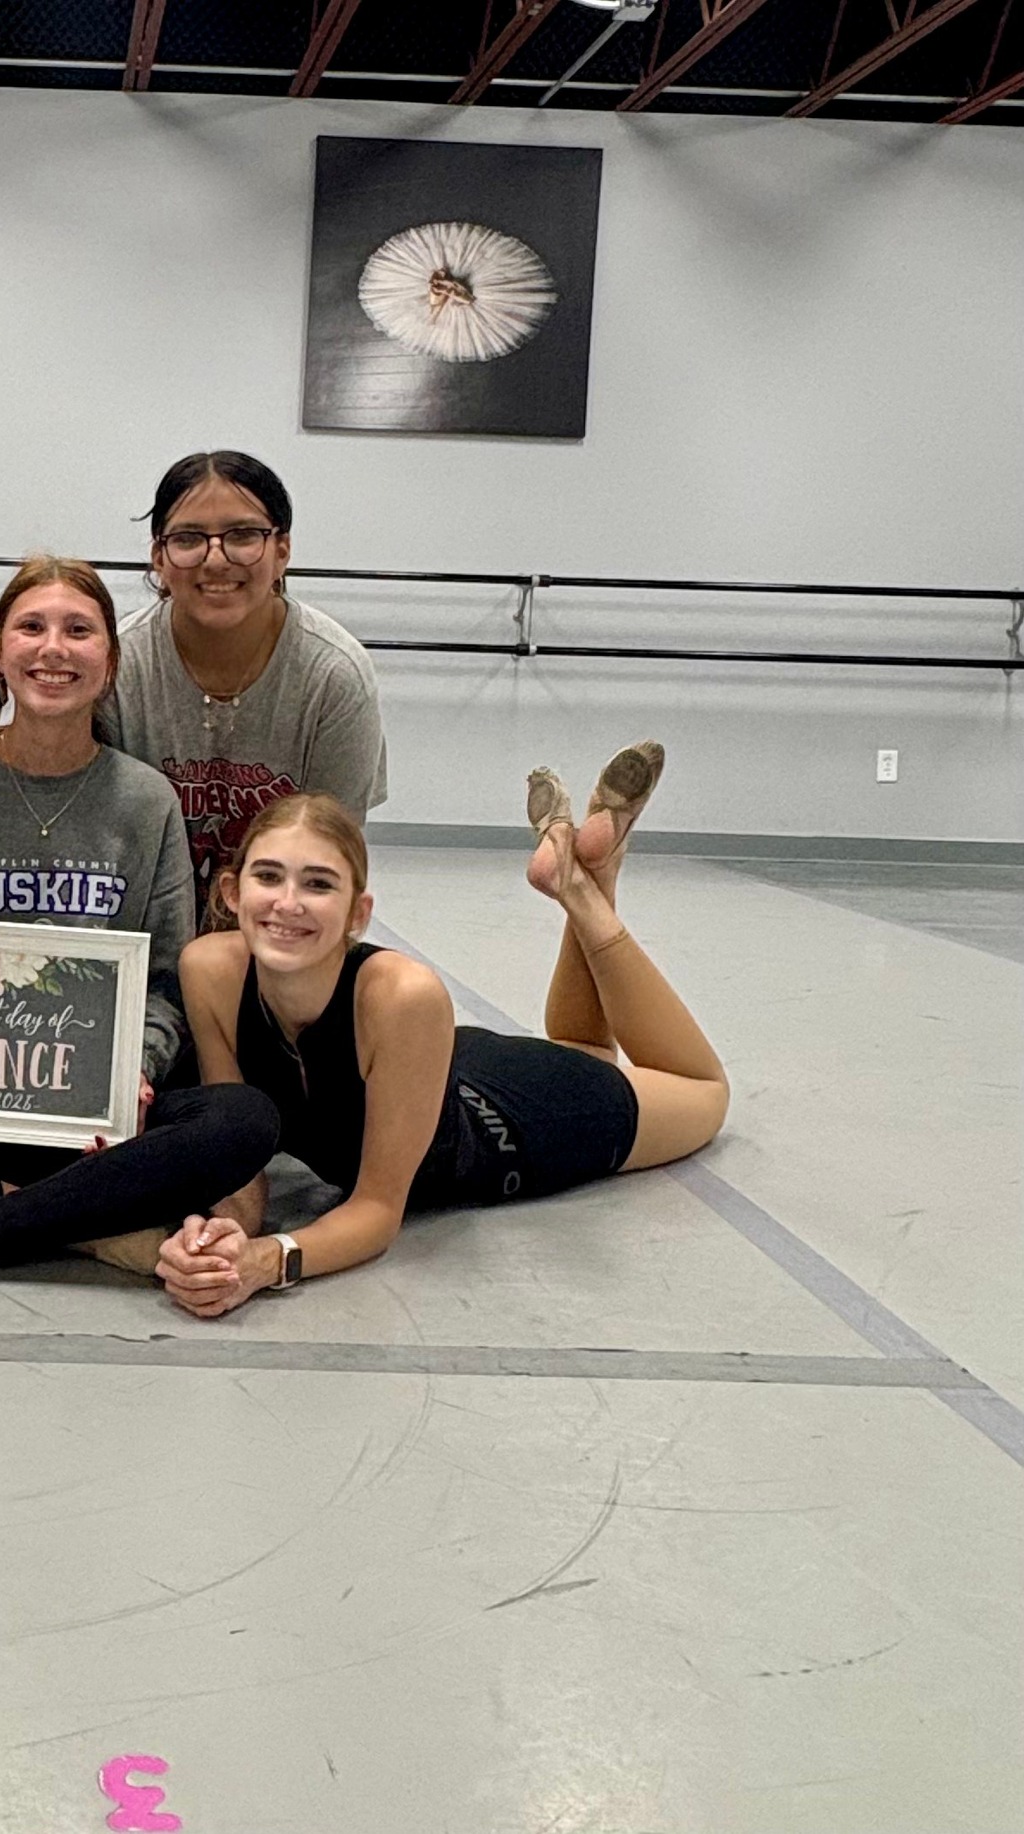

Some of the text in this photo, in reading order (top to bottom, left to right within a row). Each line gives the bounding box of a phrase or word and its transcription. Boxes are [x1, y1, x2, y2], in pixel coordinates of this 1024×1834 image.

[5, 1001, 45, 1036] day
[48, 1004, 96, 1038] of
[97, 1754, 183, 1833] 3
